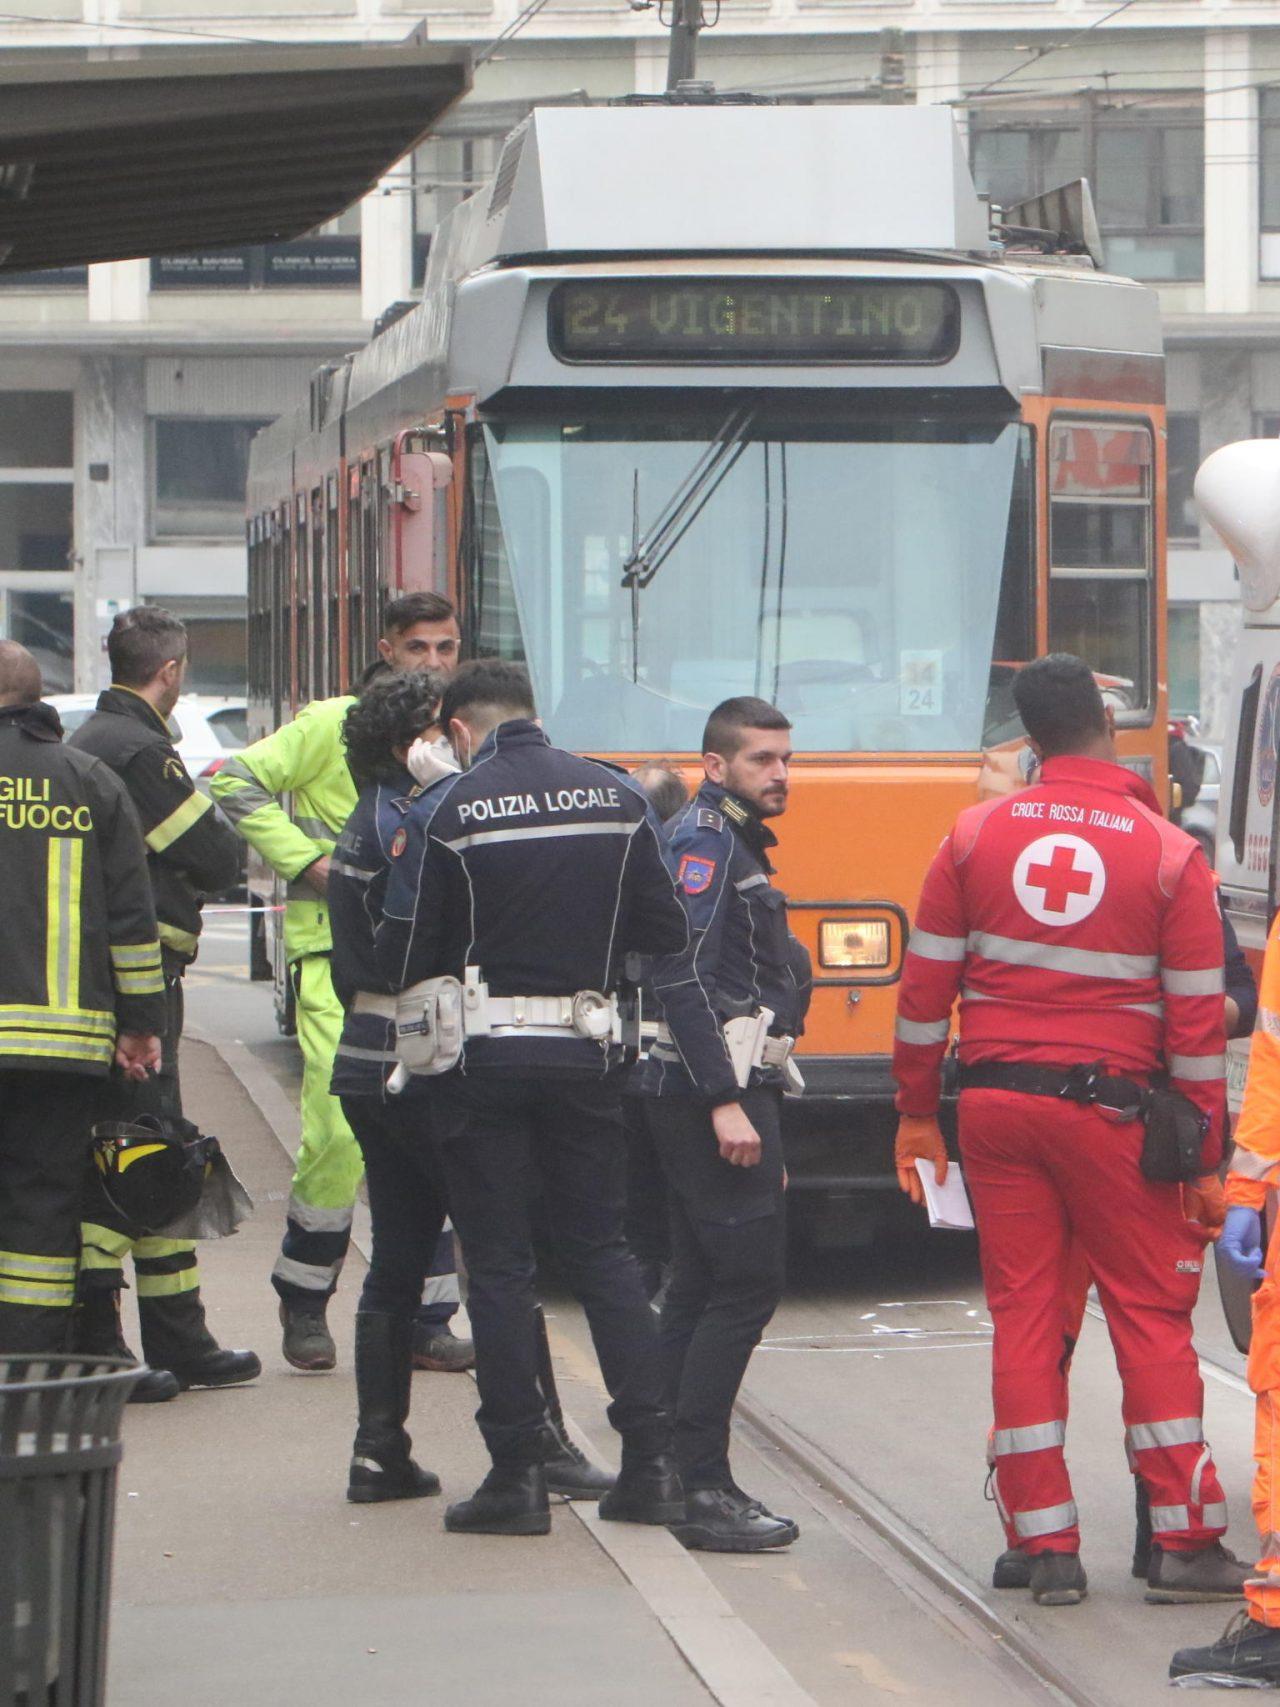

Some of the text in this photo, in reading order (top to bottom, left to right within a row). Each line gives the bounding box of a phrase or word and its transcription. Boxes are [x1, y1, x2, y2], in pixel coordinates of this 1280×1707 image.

[571, 294, 923, 336] 24 VIGENTINO
[908, 688, 936, 710] 24
[458, 787, 621, 825] POLIZIA LOCALE
[1011, 802, 1136, 834] CROCE ROSSA ITALIANA
